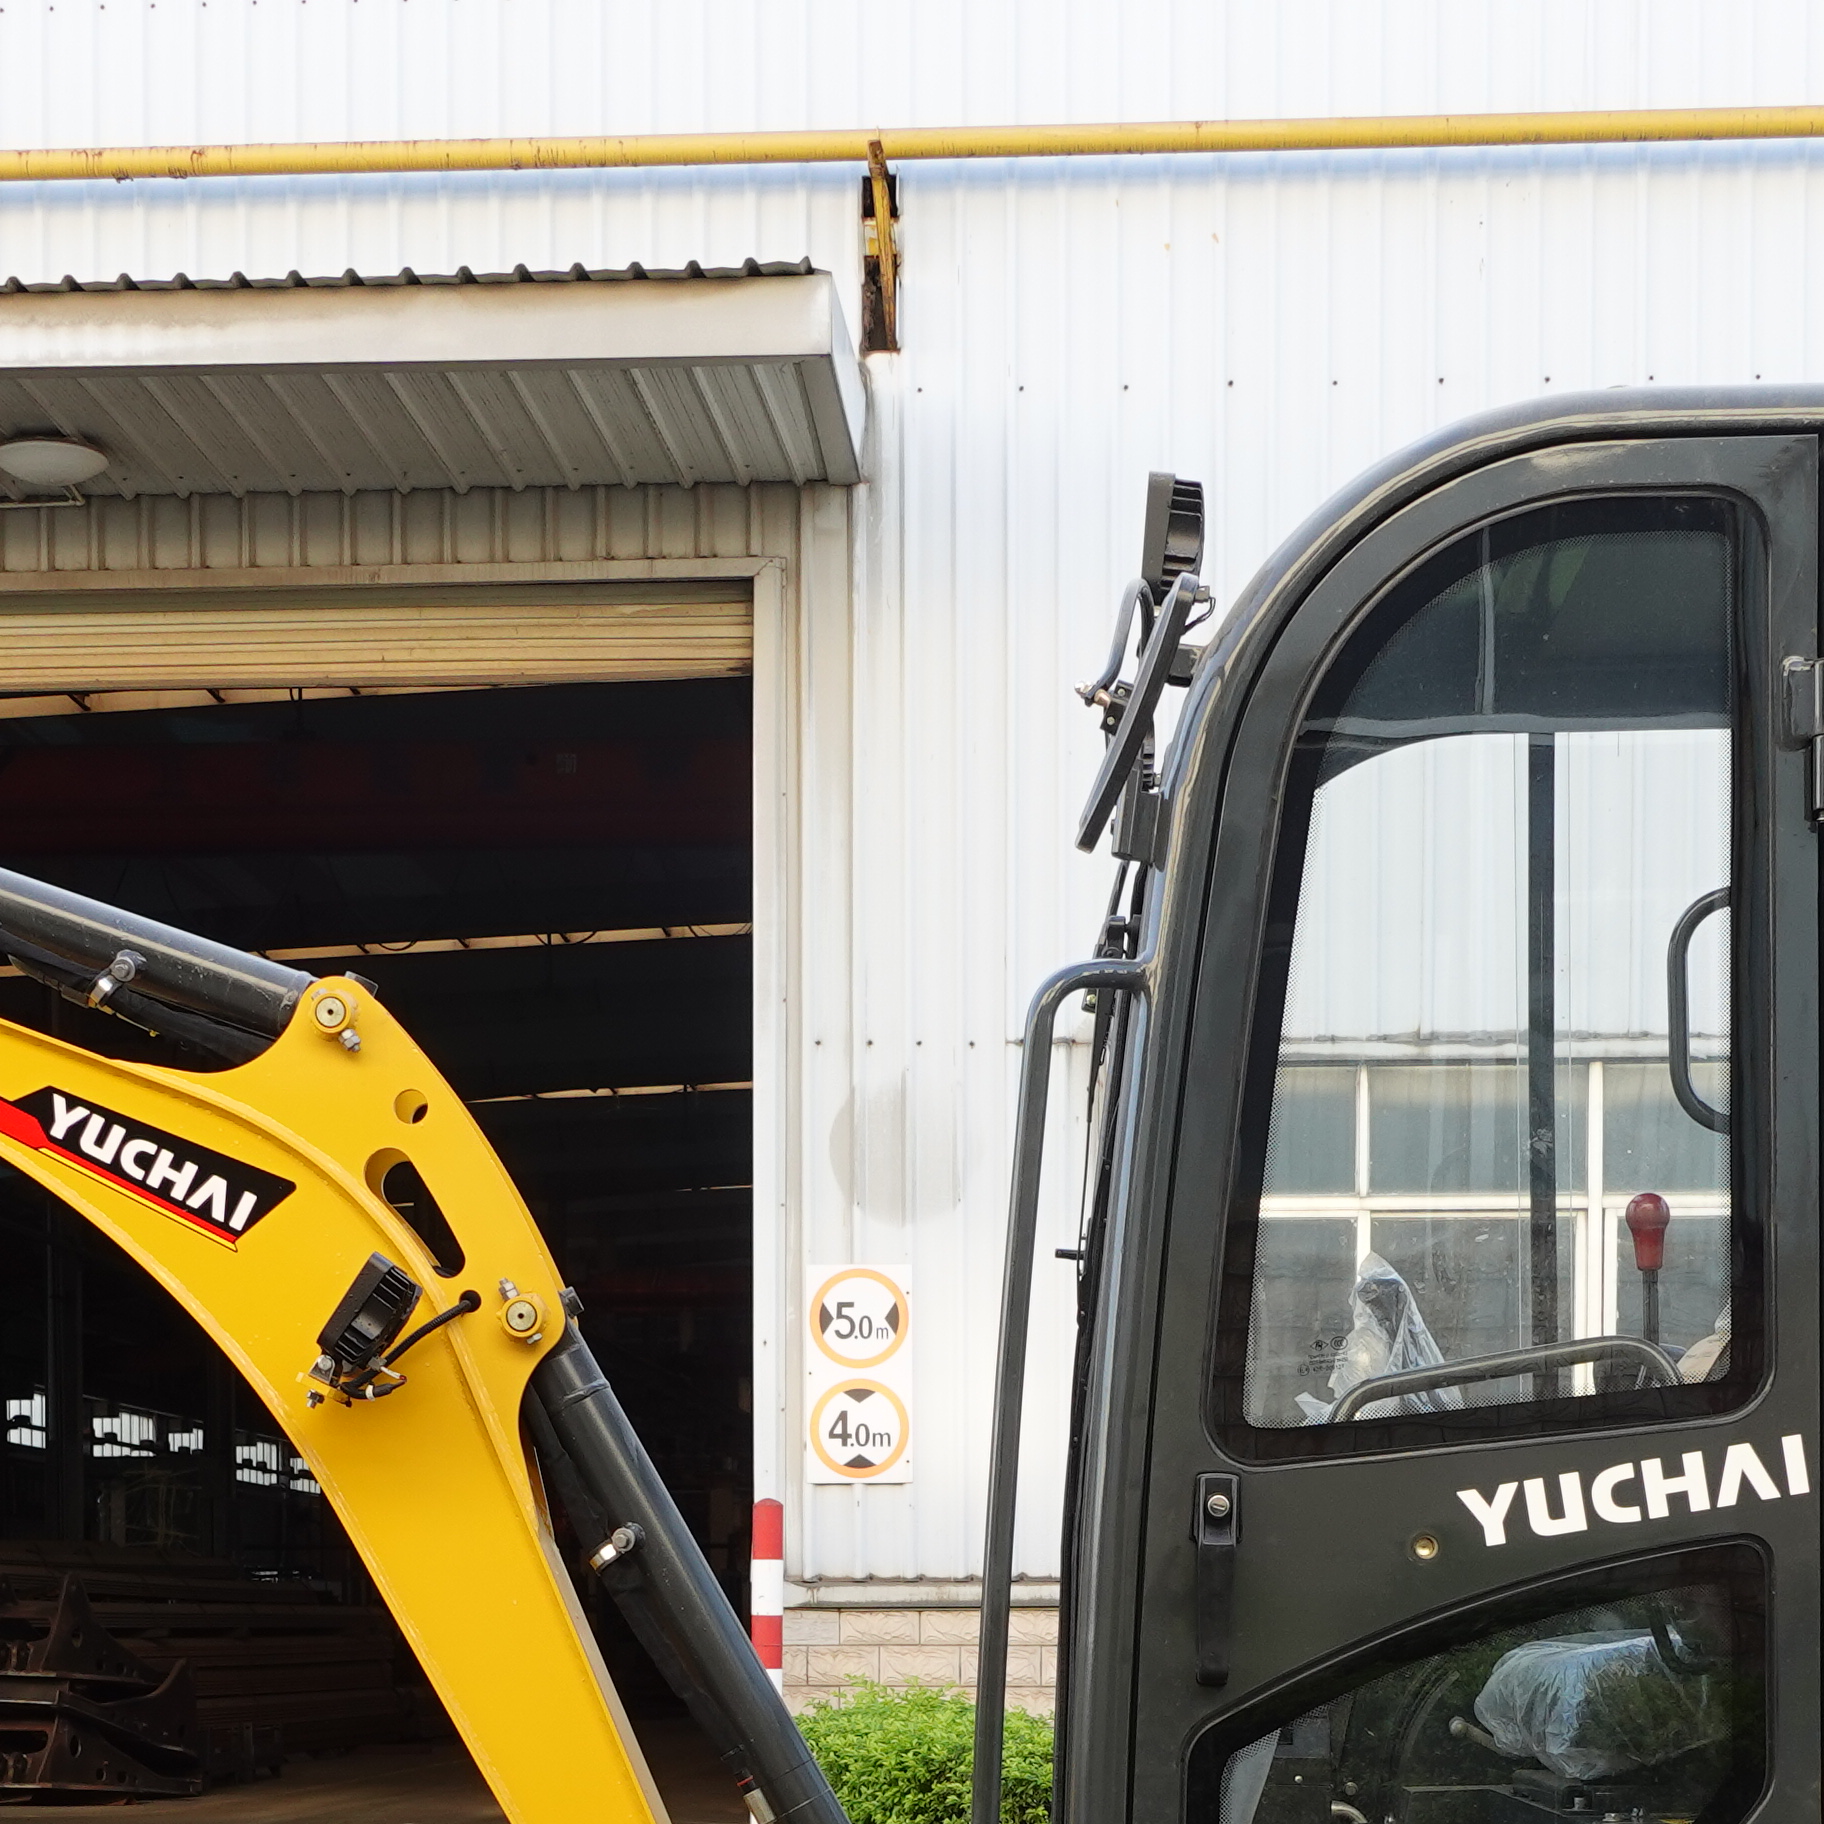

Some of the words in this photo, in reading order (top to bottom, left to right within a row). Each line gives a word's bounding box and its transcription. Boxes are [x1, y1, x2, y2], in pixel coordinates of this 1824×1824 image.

[50, 1092, 257, 1232] YUCHAI
[828, 1410, 891, 1448] 4.0m
[1456, 1433, 1809, 1547] YUCHAI
